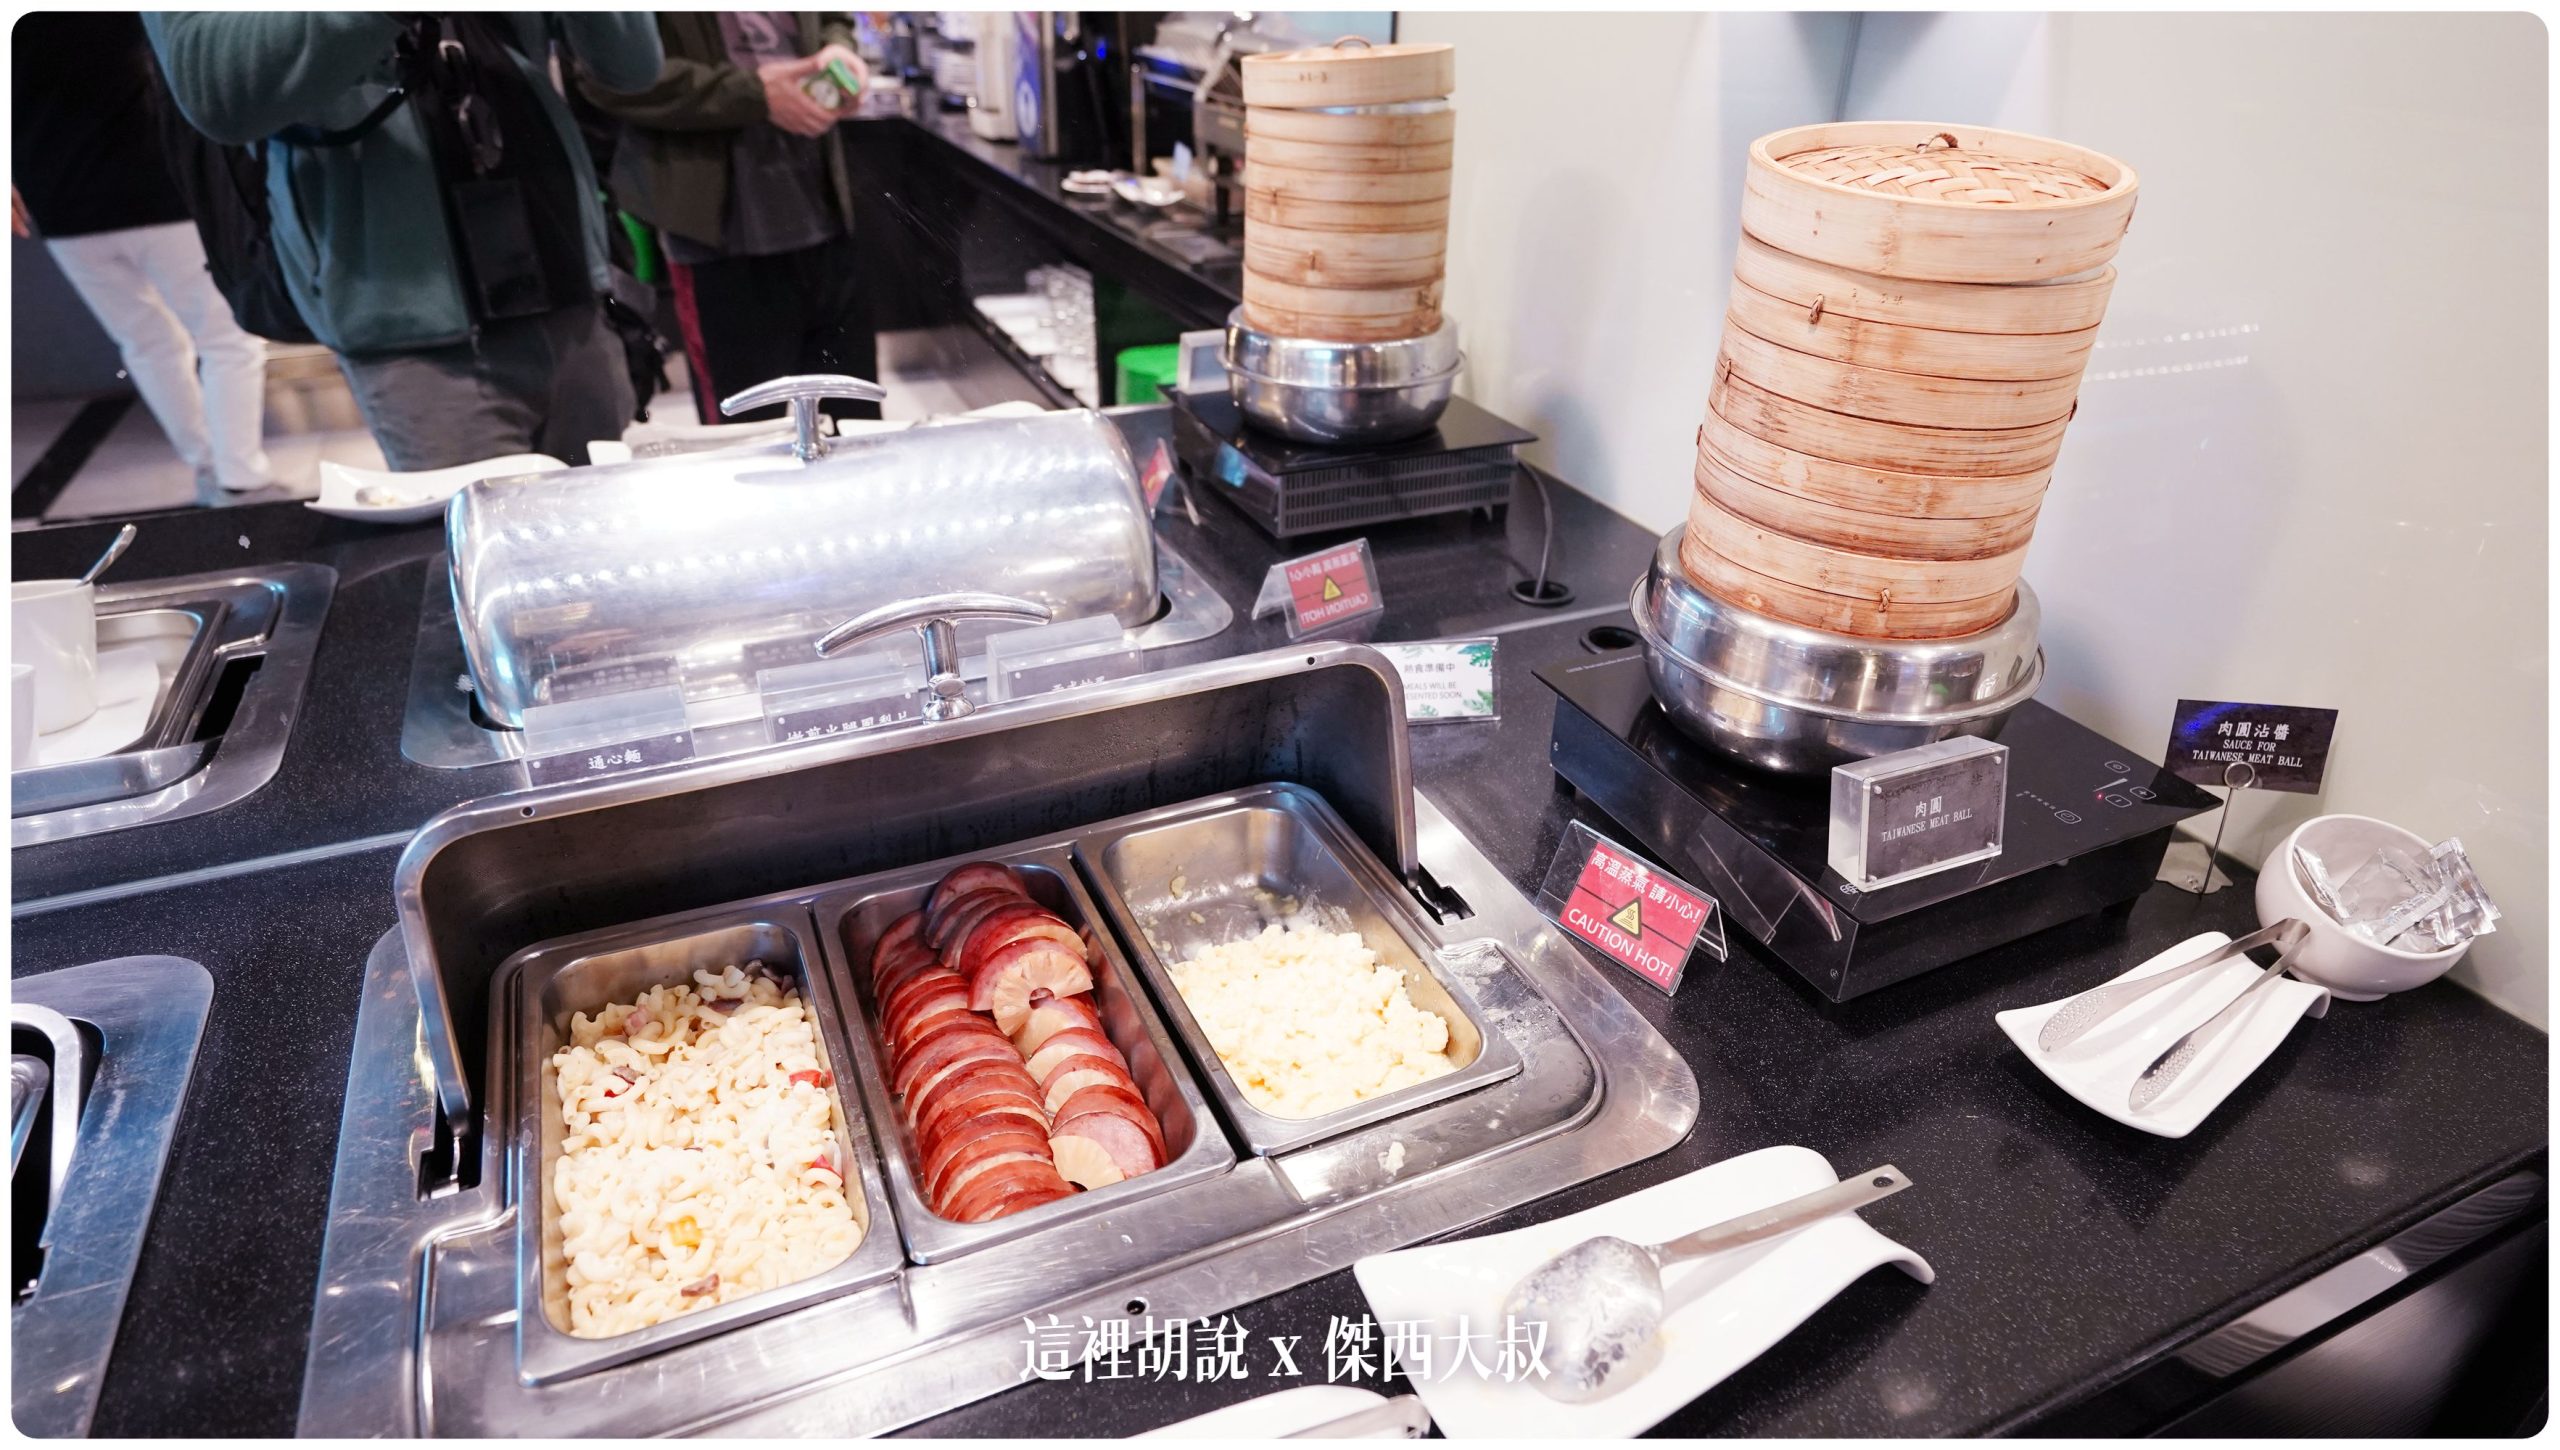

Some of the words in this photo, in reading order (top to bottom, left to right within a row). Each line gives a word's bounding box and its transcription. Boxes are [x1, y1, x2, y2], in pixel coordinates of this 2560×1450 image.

[2217, 721, 2290, 741] 肉圓沾醬
[2222, 740, 2253, 751] SAUCE
[2257, 741, 2277, 752] FOR
[588, 748, 643, 770] 通心麵
[2192, 750, 2244, 763] TAIWANESE
[2248, 753, 2274, 765] MEAT
[2277, 756, 2303, 768] BALL
[1914, 796, 1942, 818] 肉圓
[1881, 820, 1926, 843] TAIWANESE
[1929, 814, 1950, 830] MEAT
[1953, 808, 1973, 822] BALL
[1591, 851, 1650, 894] 高溫蒸氣
[1648, 883, 1701, 923] 請小心!
[1568, 908, 1635, 957] CAUTION
[1634, 947, 1675, 981] HOT!
